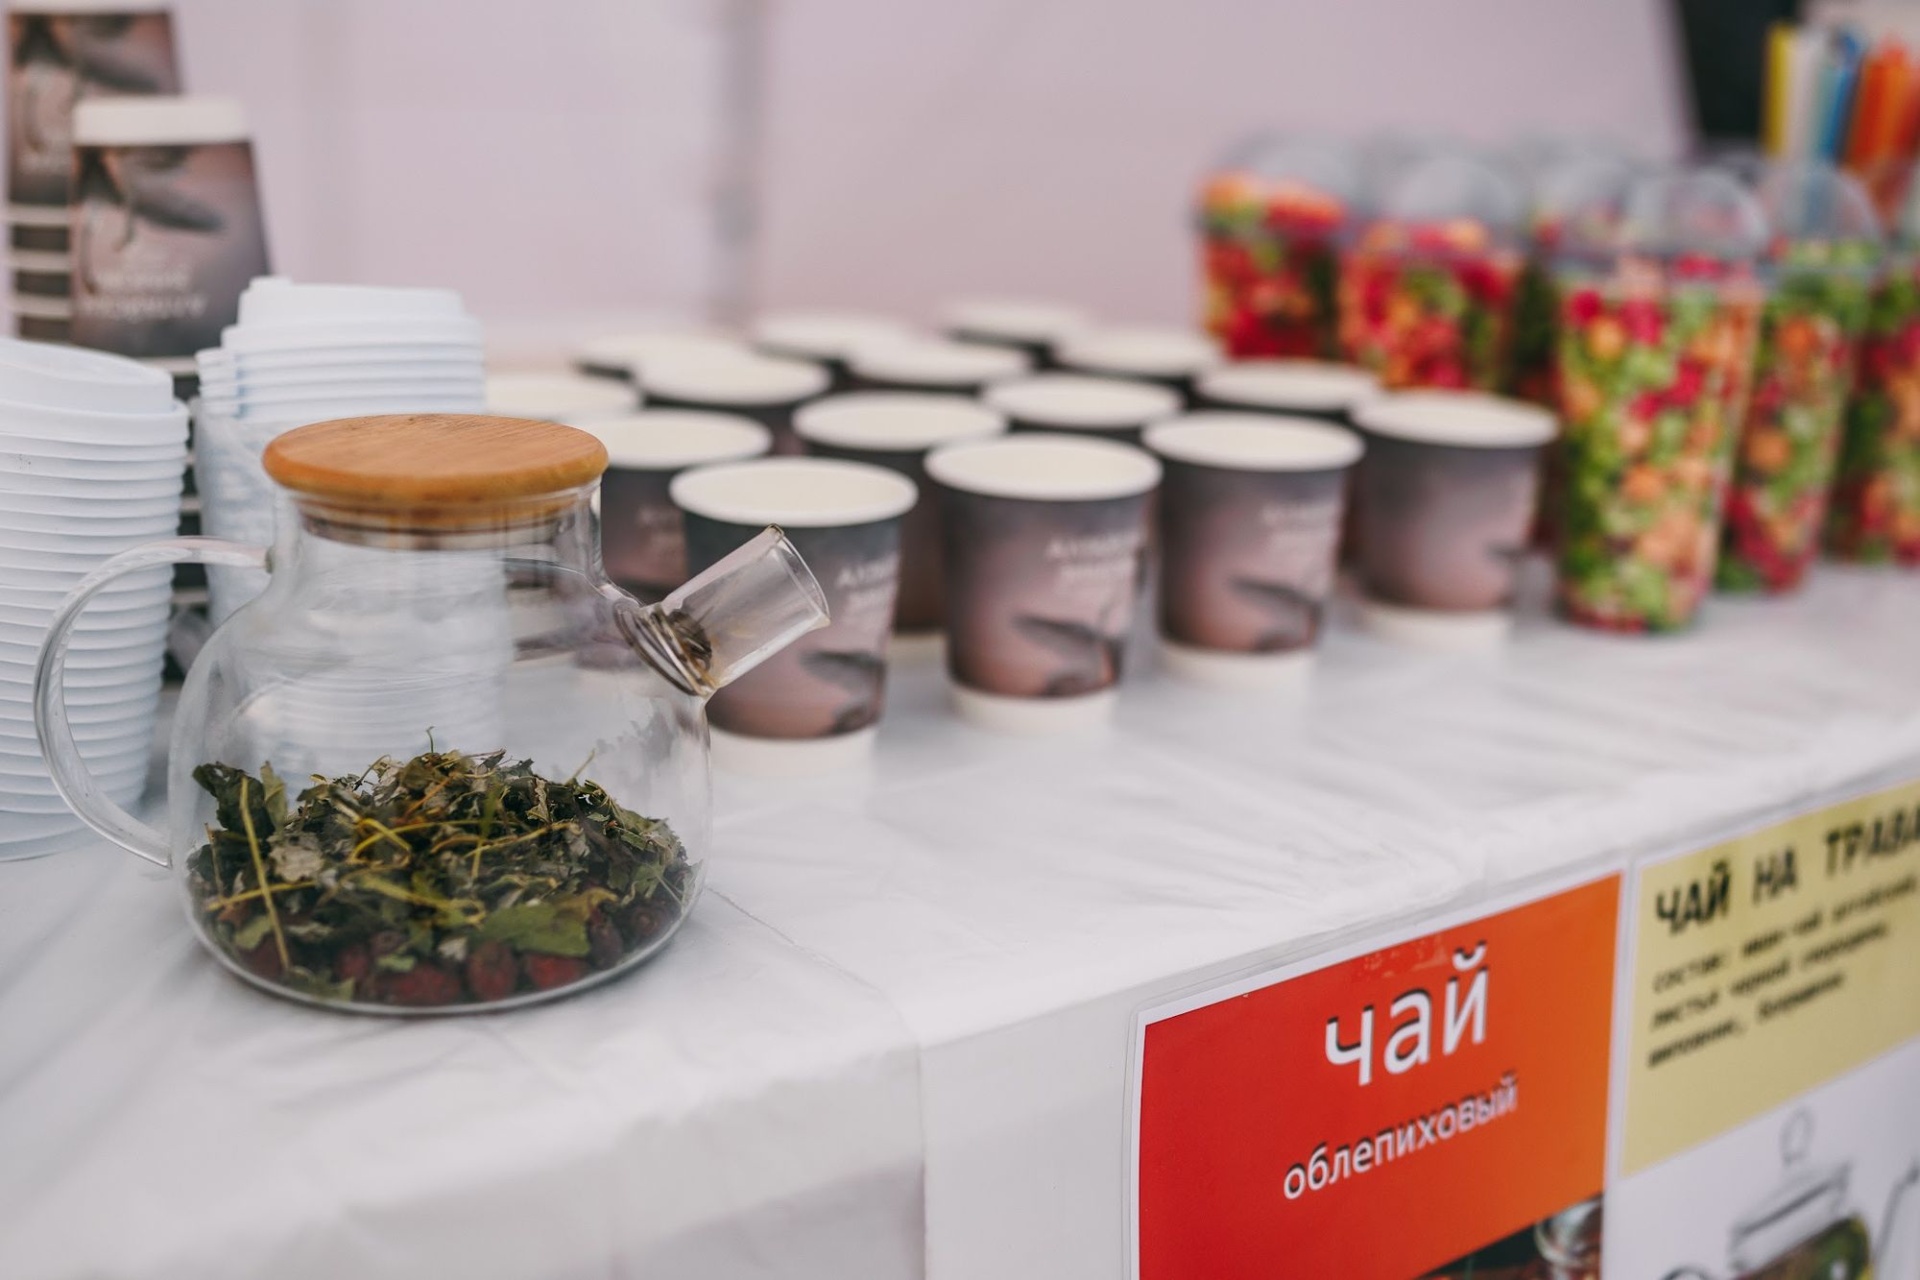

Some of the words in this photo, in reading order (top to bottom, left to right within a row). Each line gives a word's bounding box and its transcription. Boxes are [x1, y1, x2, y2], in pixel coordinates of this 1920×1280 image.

[1656, 858, 1730, 936] ЧАЙ
[1752, 847, 1798, 904] НА
[1325, 940, 1489, 1086] чай
[1283, 1070, 1518, 1200] облепиховый
